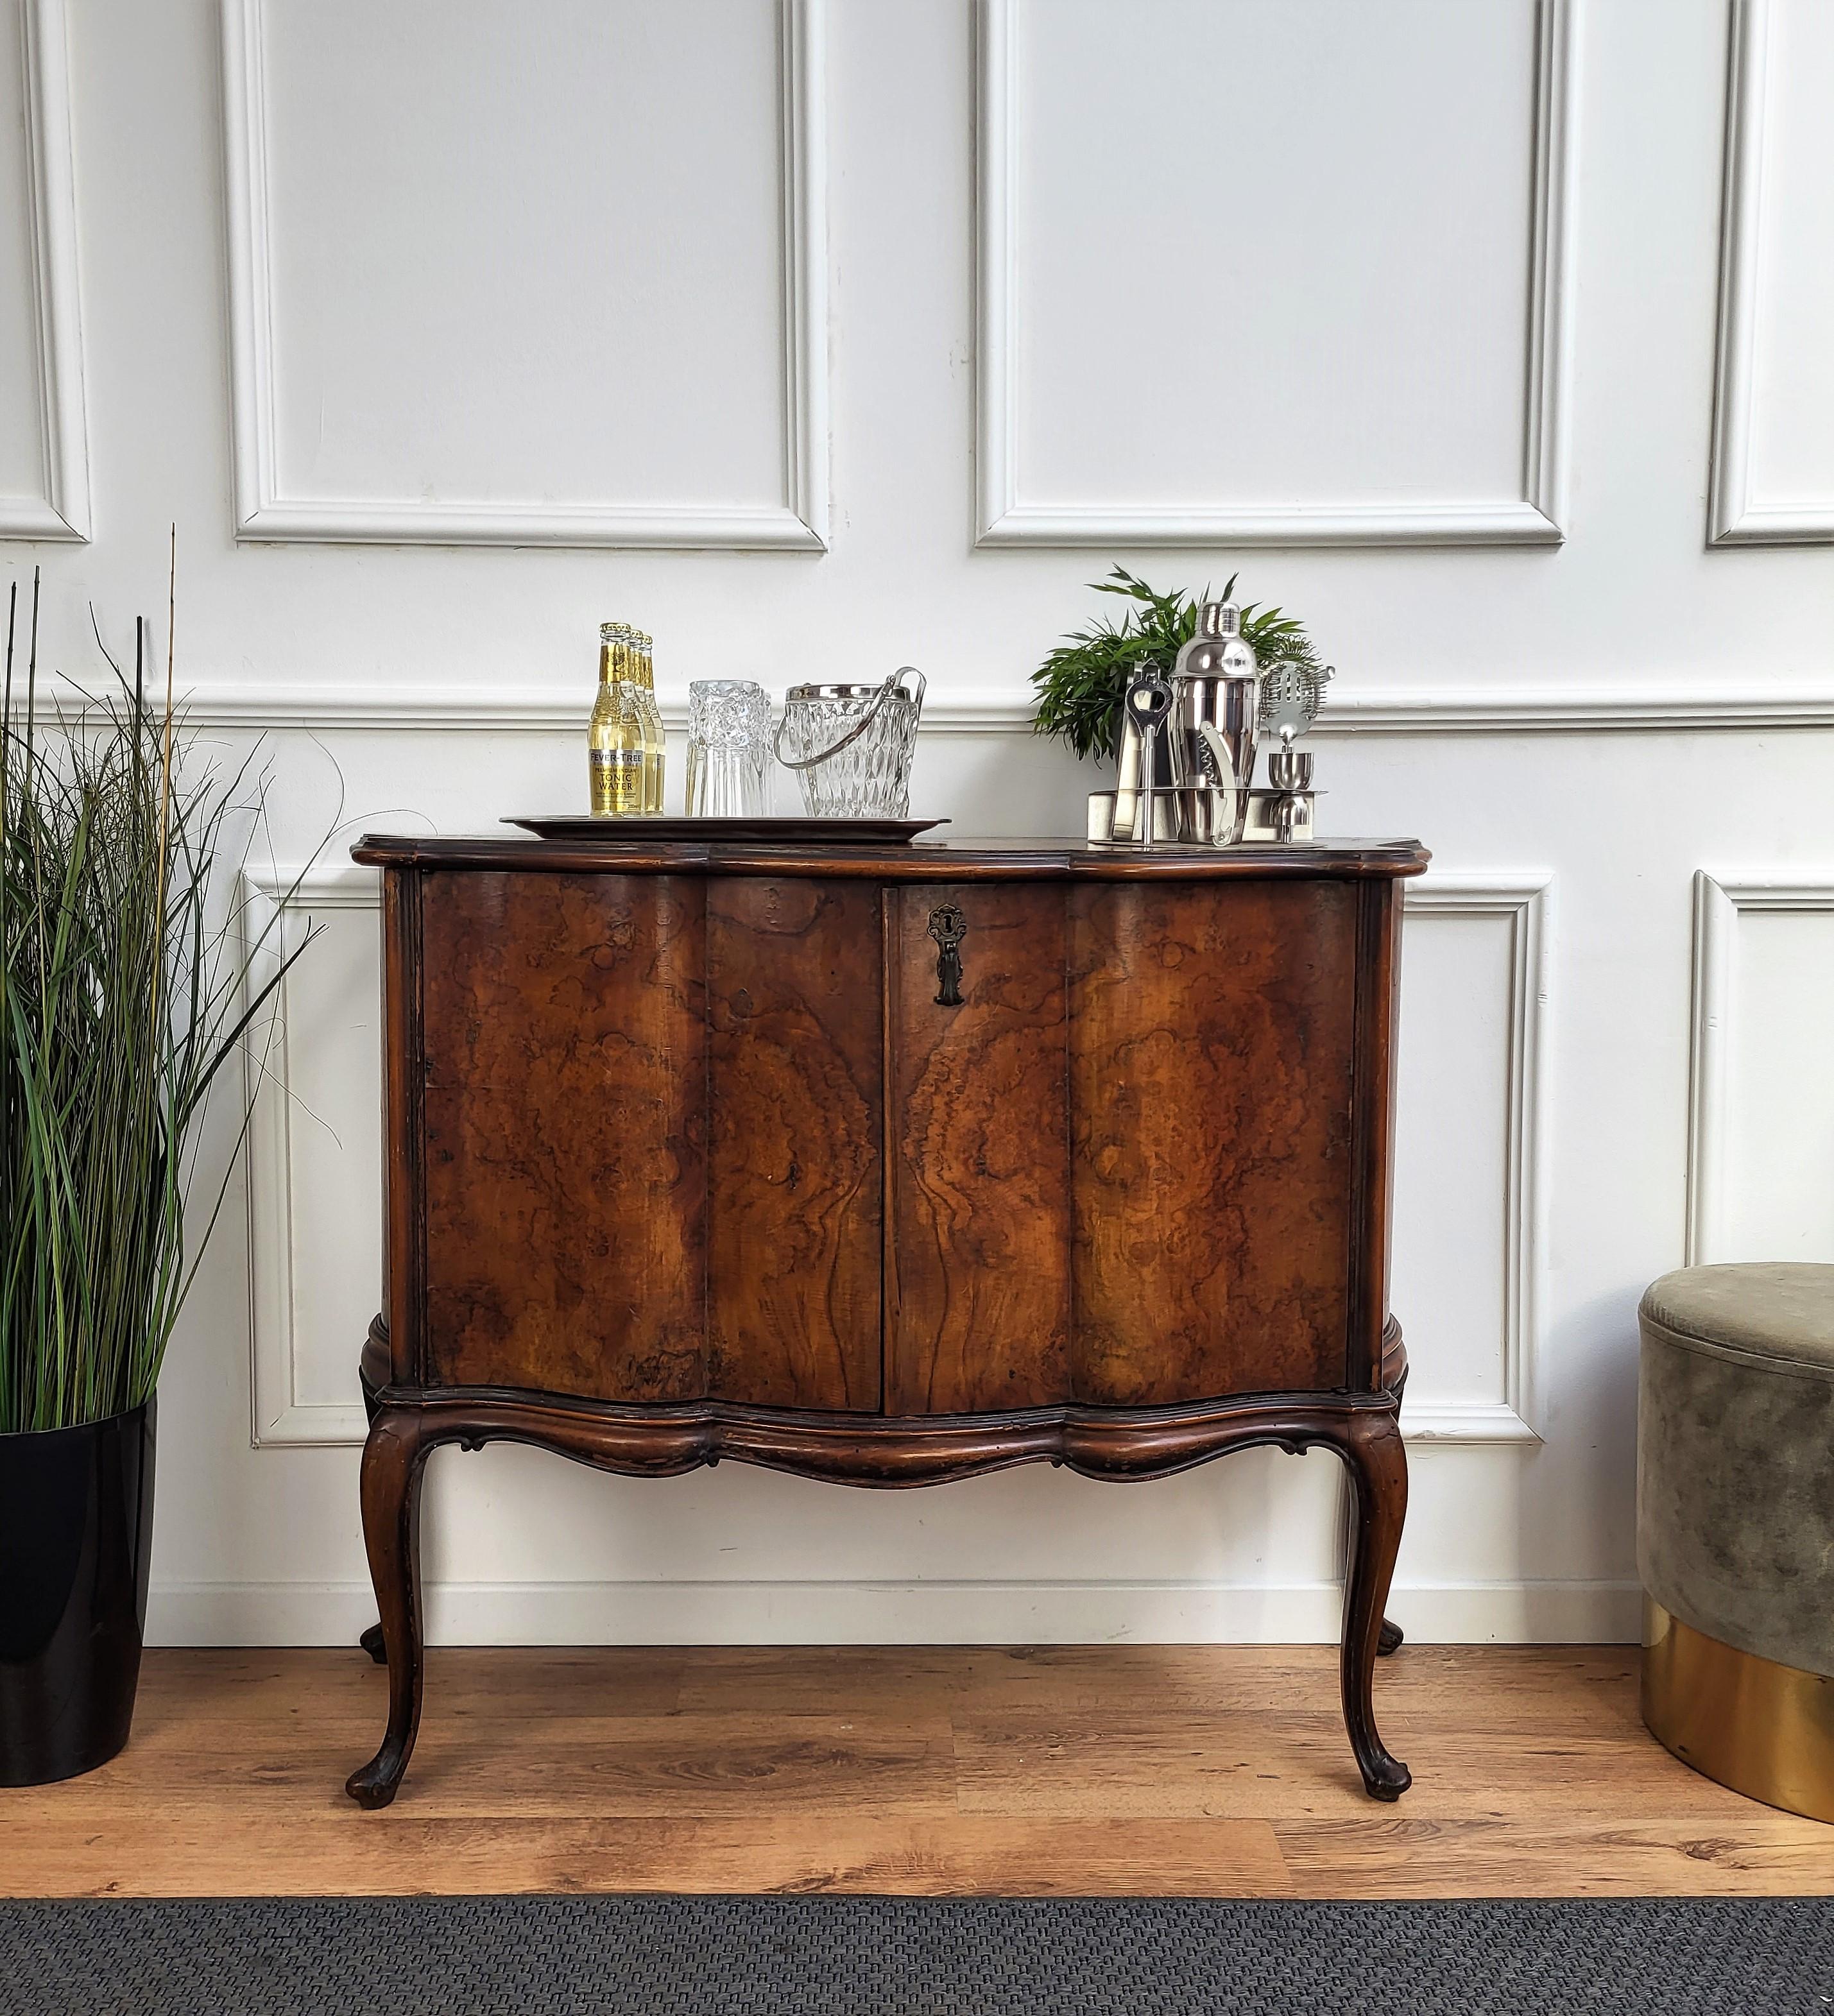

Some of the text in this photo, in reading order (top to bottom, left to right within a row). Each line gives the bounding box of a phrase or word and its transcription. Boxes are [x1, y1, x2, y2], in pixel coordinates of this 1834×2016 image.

[590, 753, 642, 762] FEVER-TREE
[600, 774, 632, 782] TONIC
[599, 782, 633, 790] WATER
